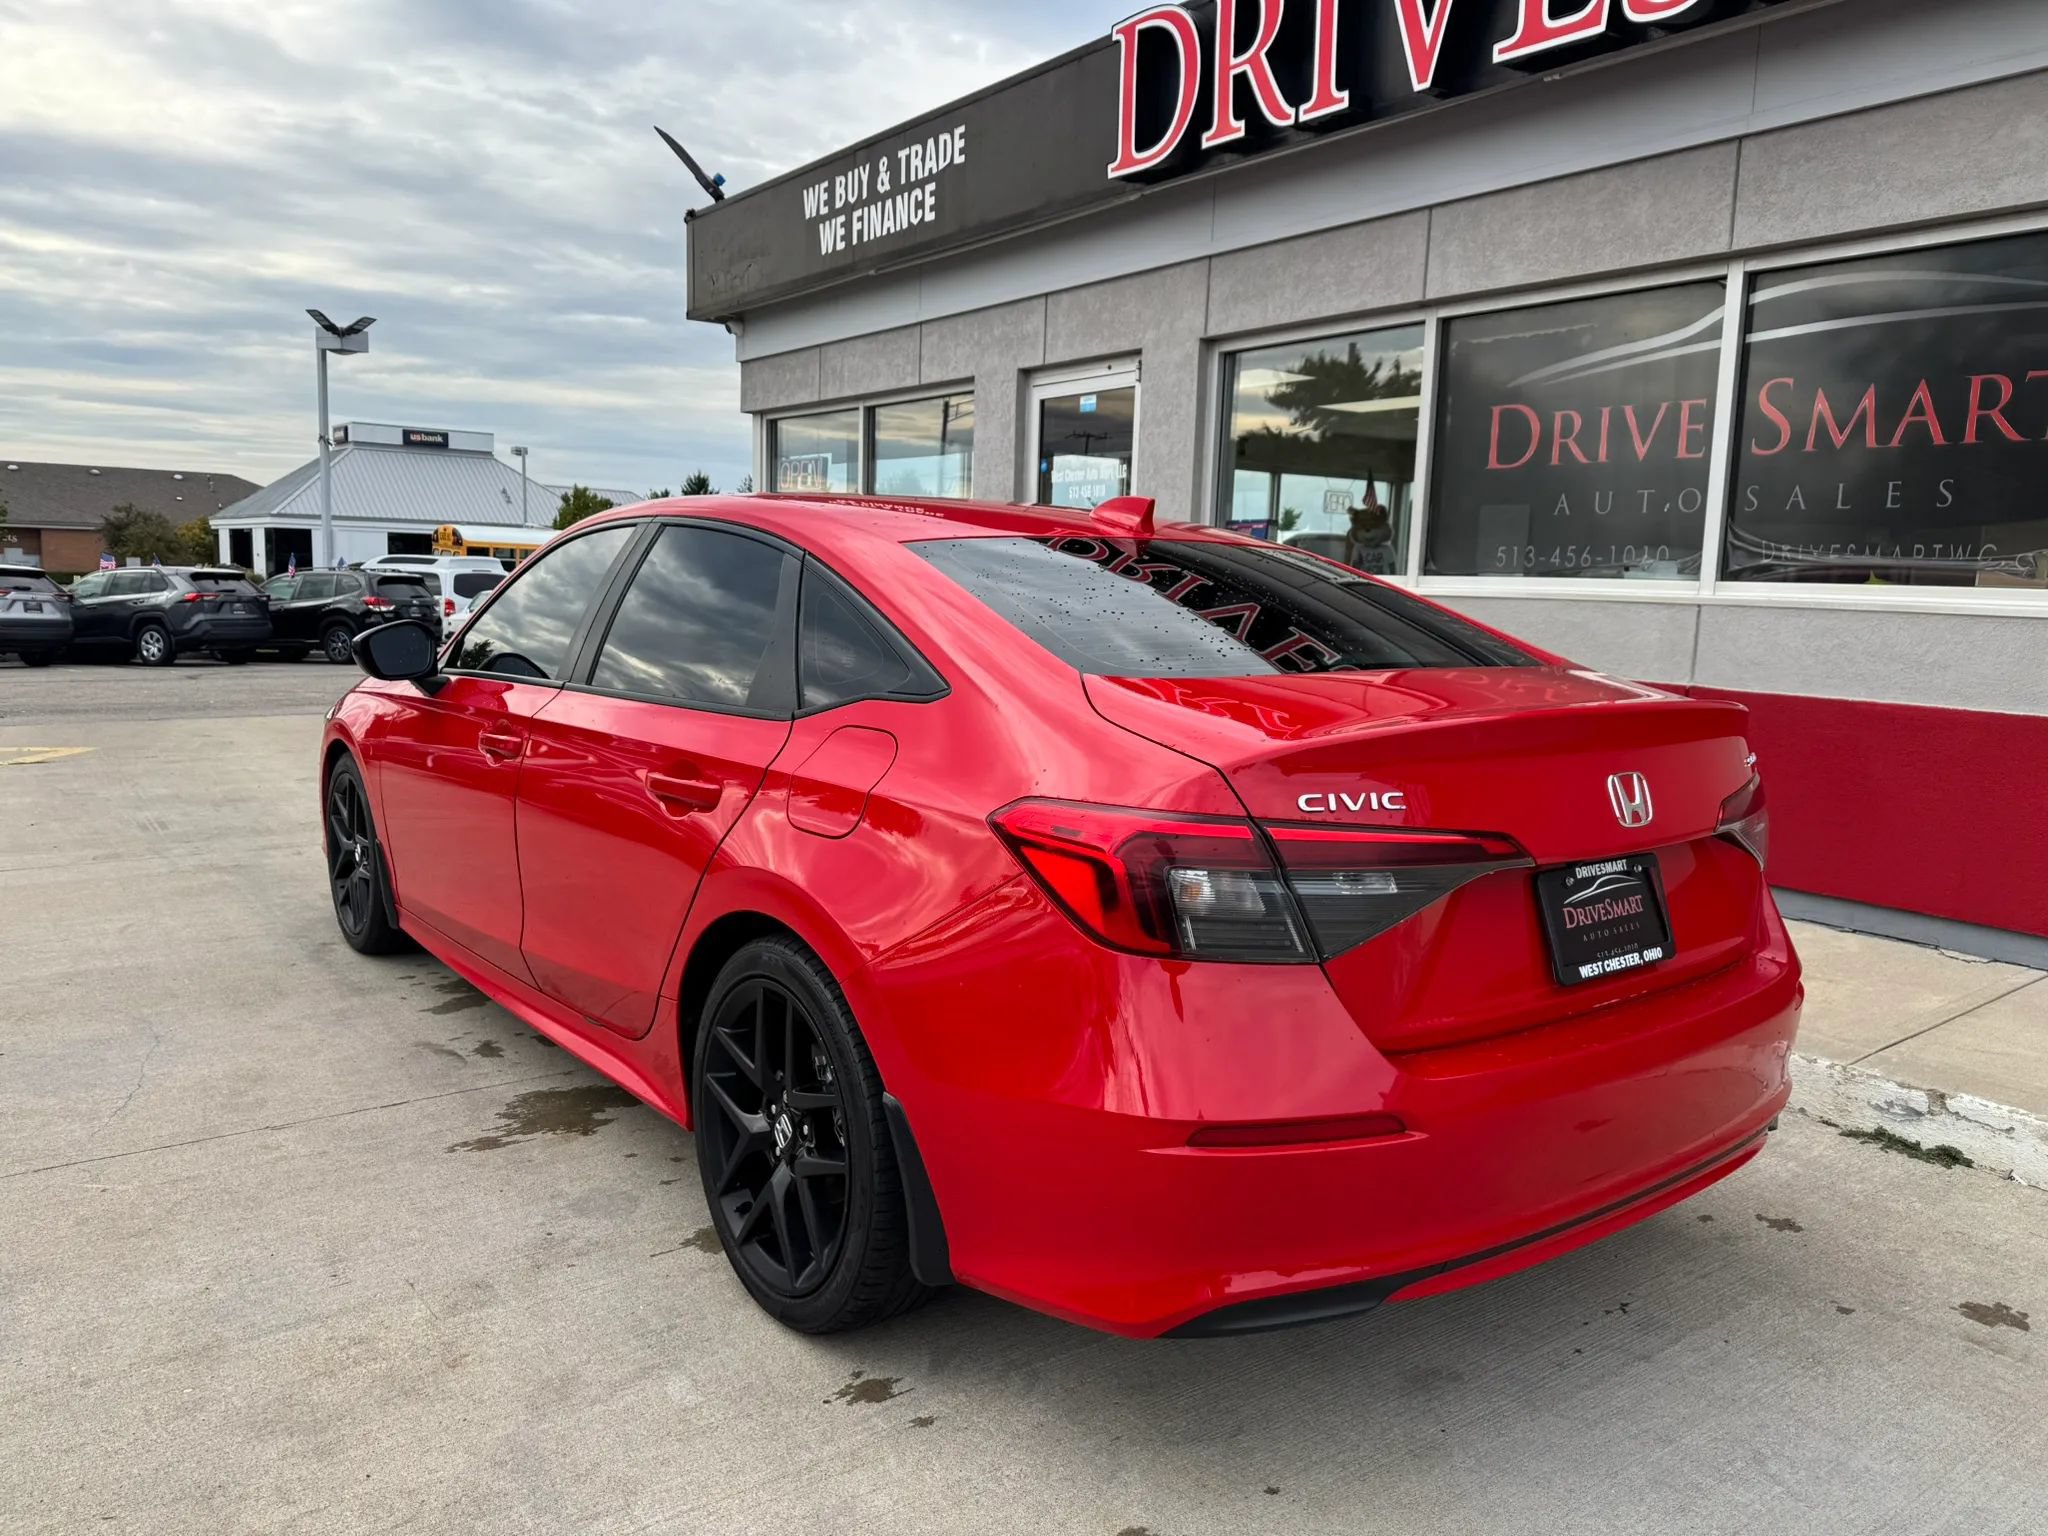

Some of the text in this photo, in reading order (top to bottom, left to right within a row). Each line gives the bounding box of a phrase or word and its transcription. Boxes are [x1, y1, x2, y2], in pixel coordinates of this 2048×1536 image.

[1107, 0, 1712, 179] DRIV
[803, 124, 966, 220] WE BUY & TRADE
[819, 181, 936, 256] WE FINANCE
[1485, 399, 1708, 470] DRIVE
[1553, 479, 1955, 516] AUTO SALES
[1496, 544, 1670, 568] 513-456-1010
[1297, 792, 1406, 811] CIVIC
[1576, 859, 1627, 878] DRIVESMART
[1579, 947, 1663, 978] WEST CHESTER, OHIO
